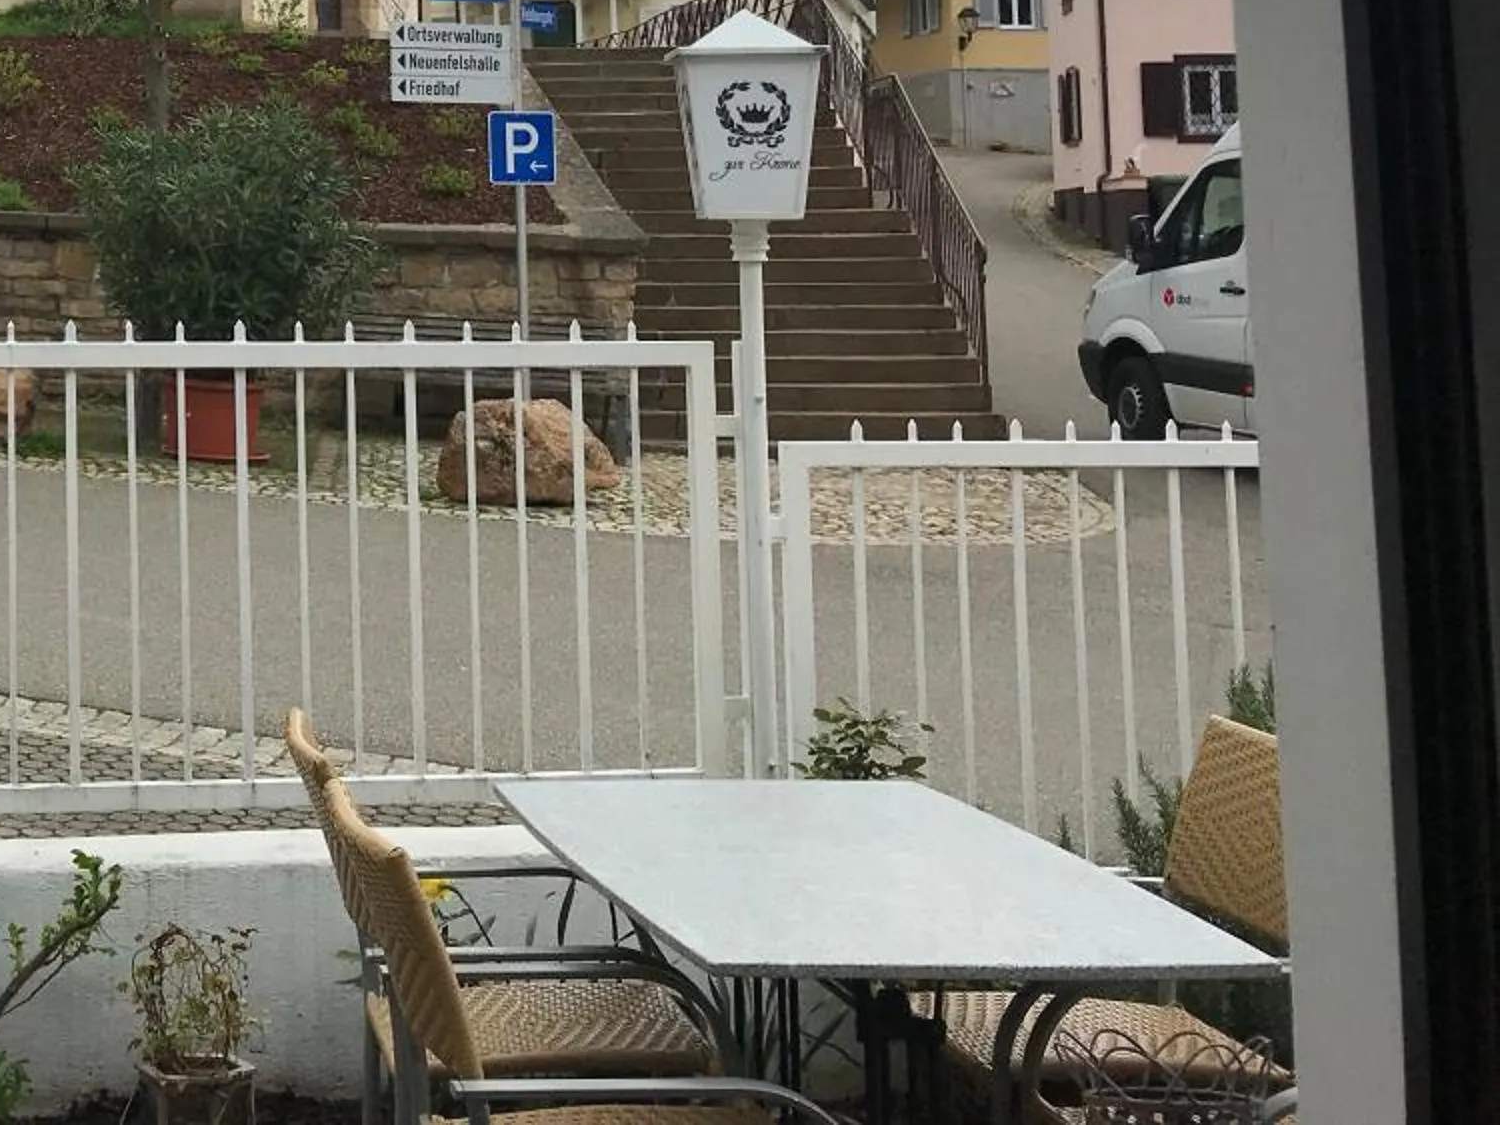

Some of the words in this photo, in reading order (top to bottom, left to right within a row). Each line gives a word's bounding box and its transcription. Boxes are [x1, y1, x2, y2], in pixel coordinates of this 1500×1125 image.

[406, 27, 503, 48] Ortsverwaltung
[408, 53, 501, 72] Neuenfelshalle
[408, 79, 461, 96] Friedhof
[505, 122, 540, 174] P
